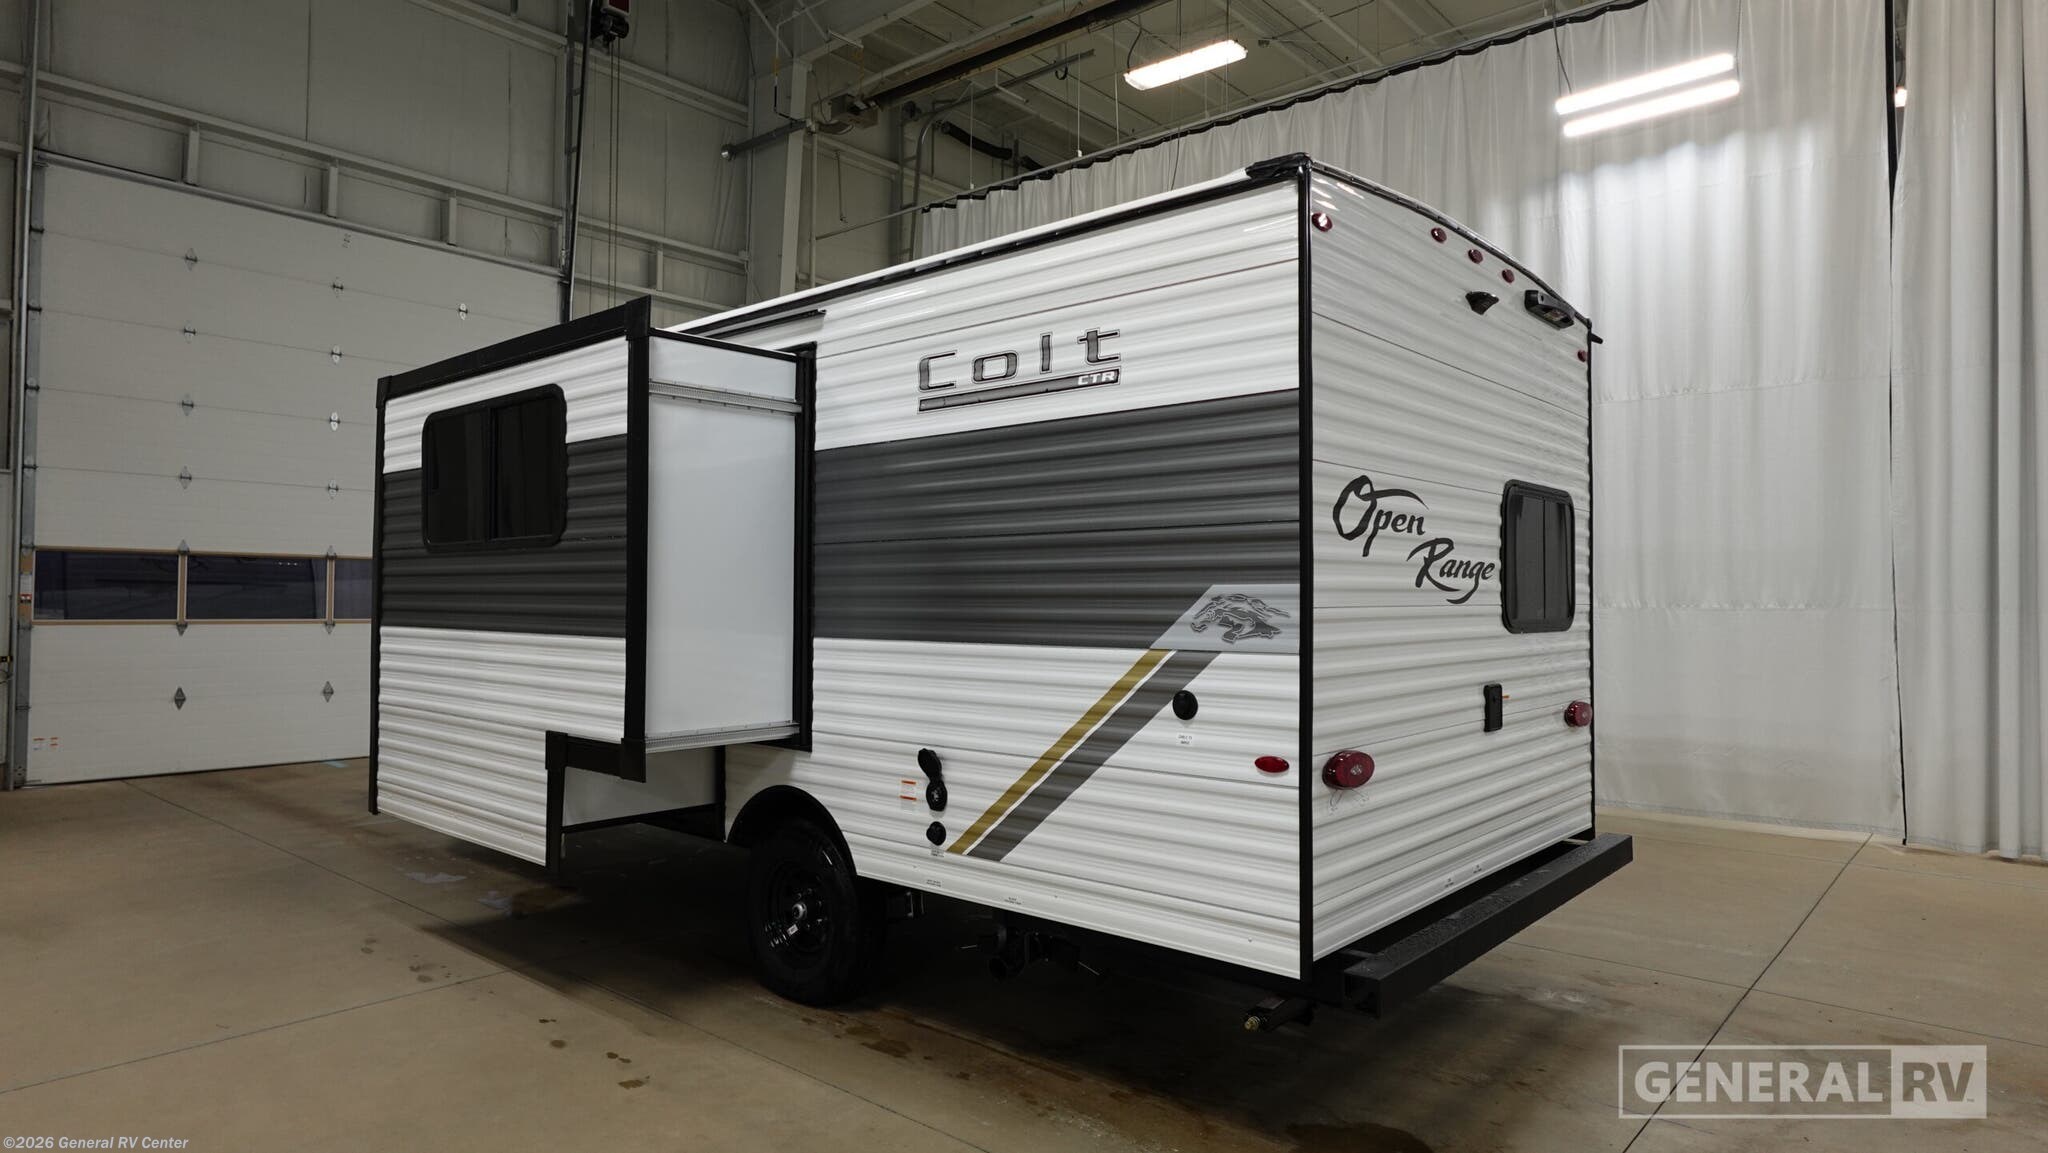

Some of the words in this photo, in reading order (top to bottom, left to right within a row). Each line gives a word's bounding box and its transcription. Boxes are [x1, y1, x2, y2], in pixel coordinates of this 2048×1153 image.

[919, 329, 1120, 391] Colt
[1077, 371, 1115, 386] CTR
[1332, 475, 1429, 557] Open
[1406, 537, 1496, 604] Range
